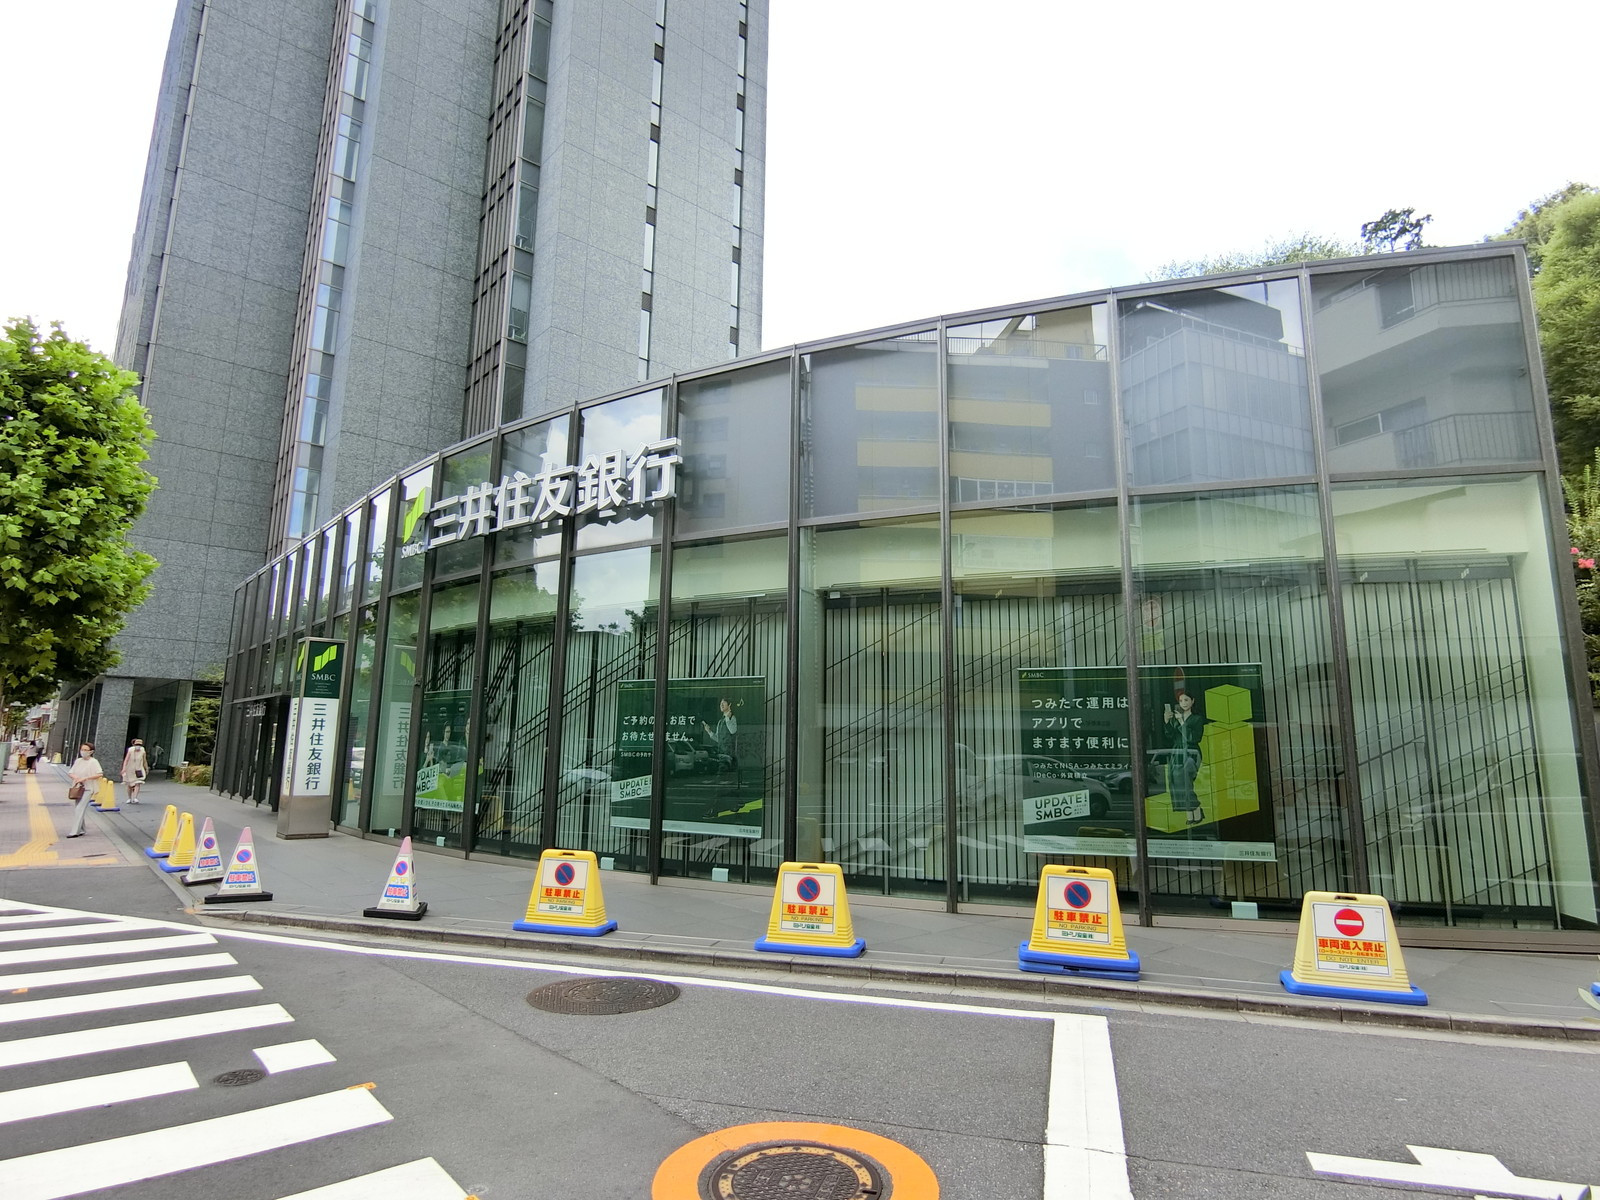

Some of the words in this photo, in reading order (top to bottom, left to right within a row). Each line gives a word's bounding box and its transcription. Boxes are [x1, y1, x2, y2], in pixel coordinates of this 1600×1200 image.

[430, 437, 682, 549] 三井住友銀行
[401, 542, 425, 559] SMBC
[311, 672, 336, 681] SMBC
[1031, 697, 1129, 709] つみたて運用は
[623, 715, 696, 726] ご予約の、お店で
[1032, 717, 1082, 728] アプリで
[621, 731, 694, 742] お待たせません。
[305, 703, 327, 790] 三井住友銀行
[1032, 737, 1129, 749] ますます便利に
[620, 777, 652, 790] UPDATE!
[620, 788, 642, 798] SMBC
[1035, 793, 1087, 809] UPDATE!
[1036, 806, 1072, 820] SMBC
[545, 888, 580, 899] 駐車禁止
[787, 904, 828, 916] 駐車禁止
[1053, 911, 1102, 924] 駐車禁止
[1318, 938, 1384, 952] 車両進入禁止
